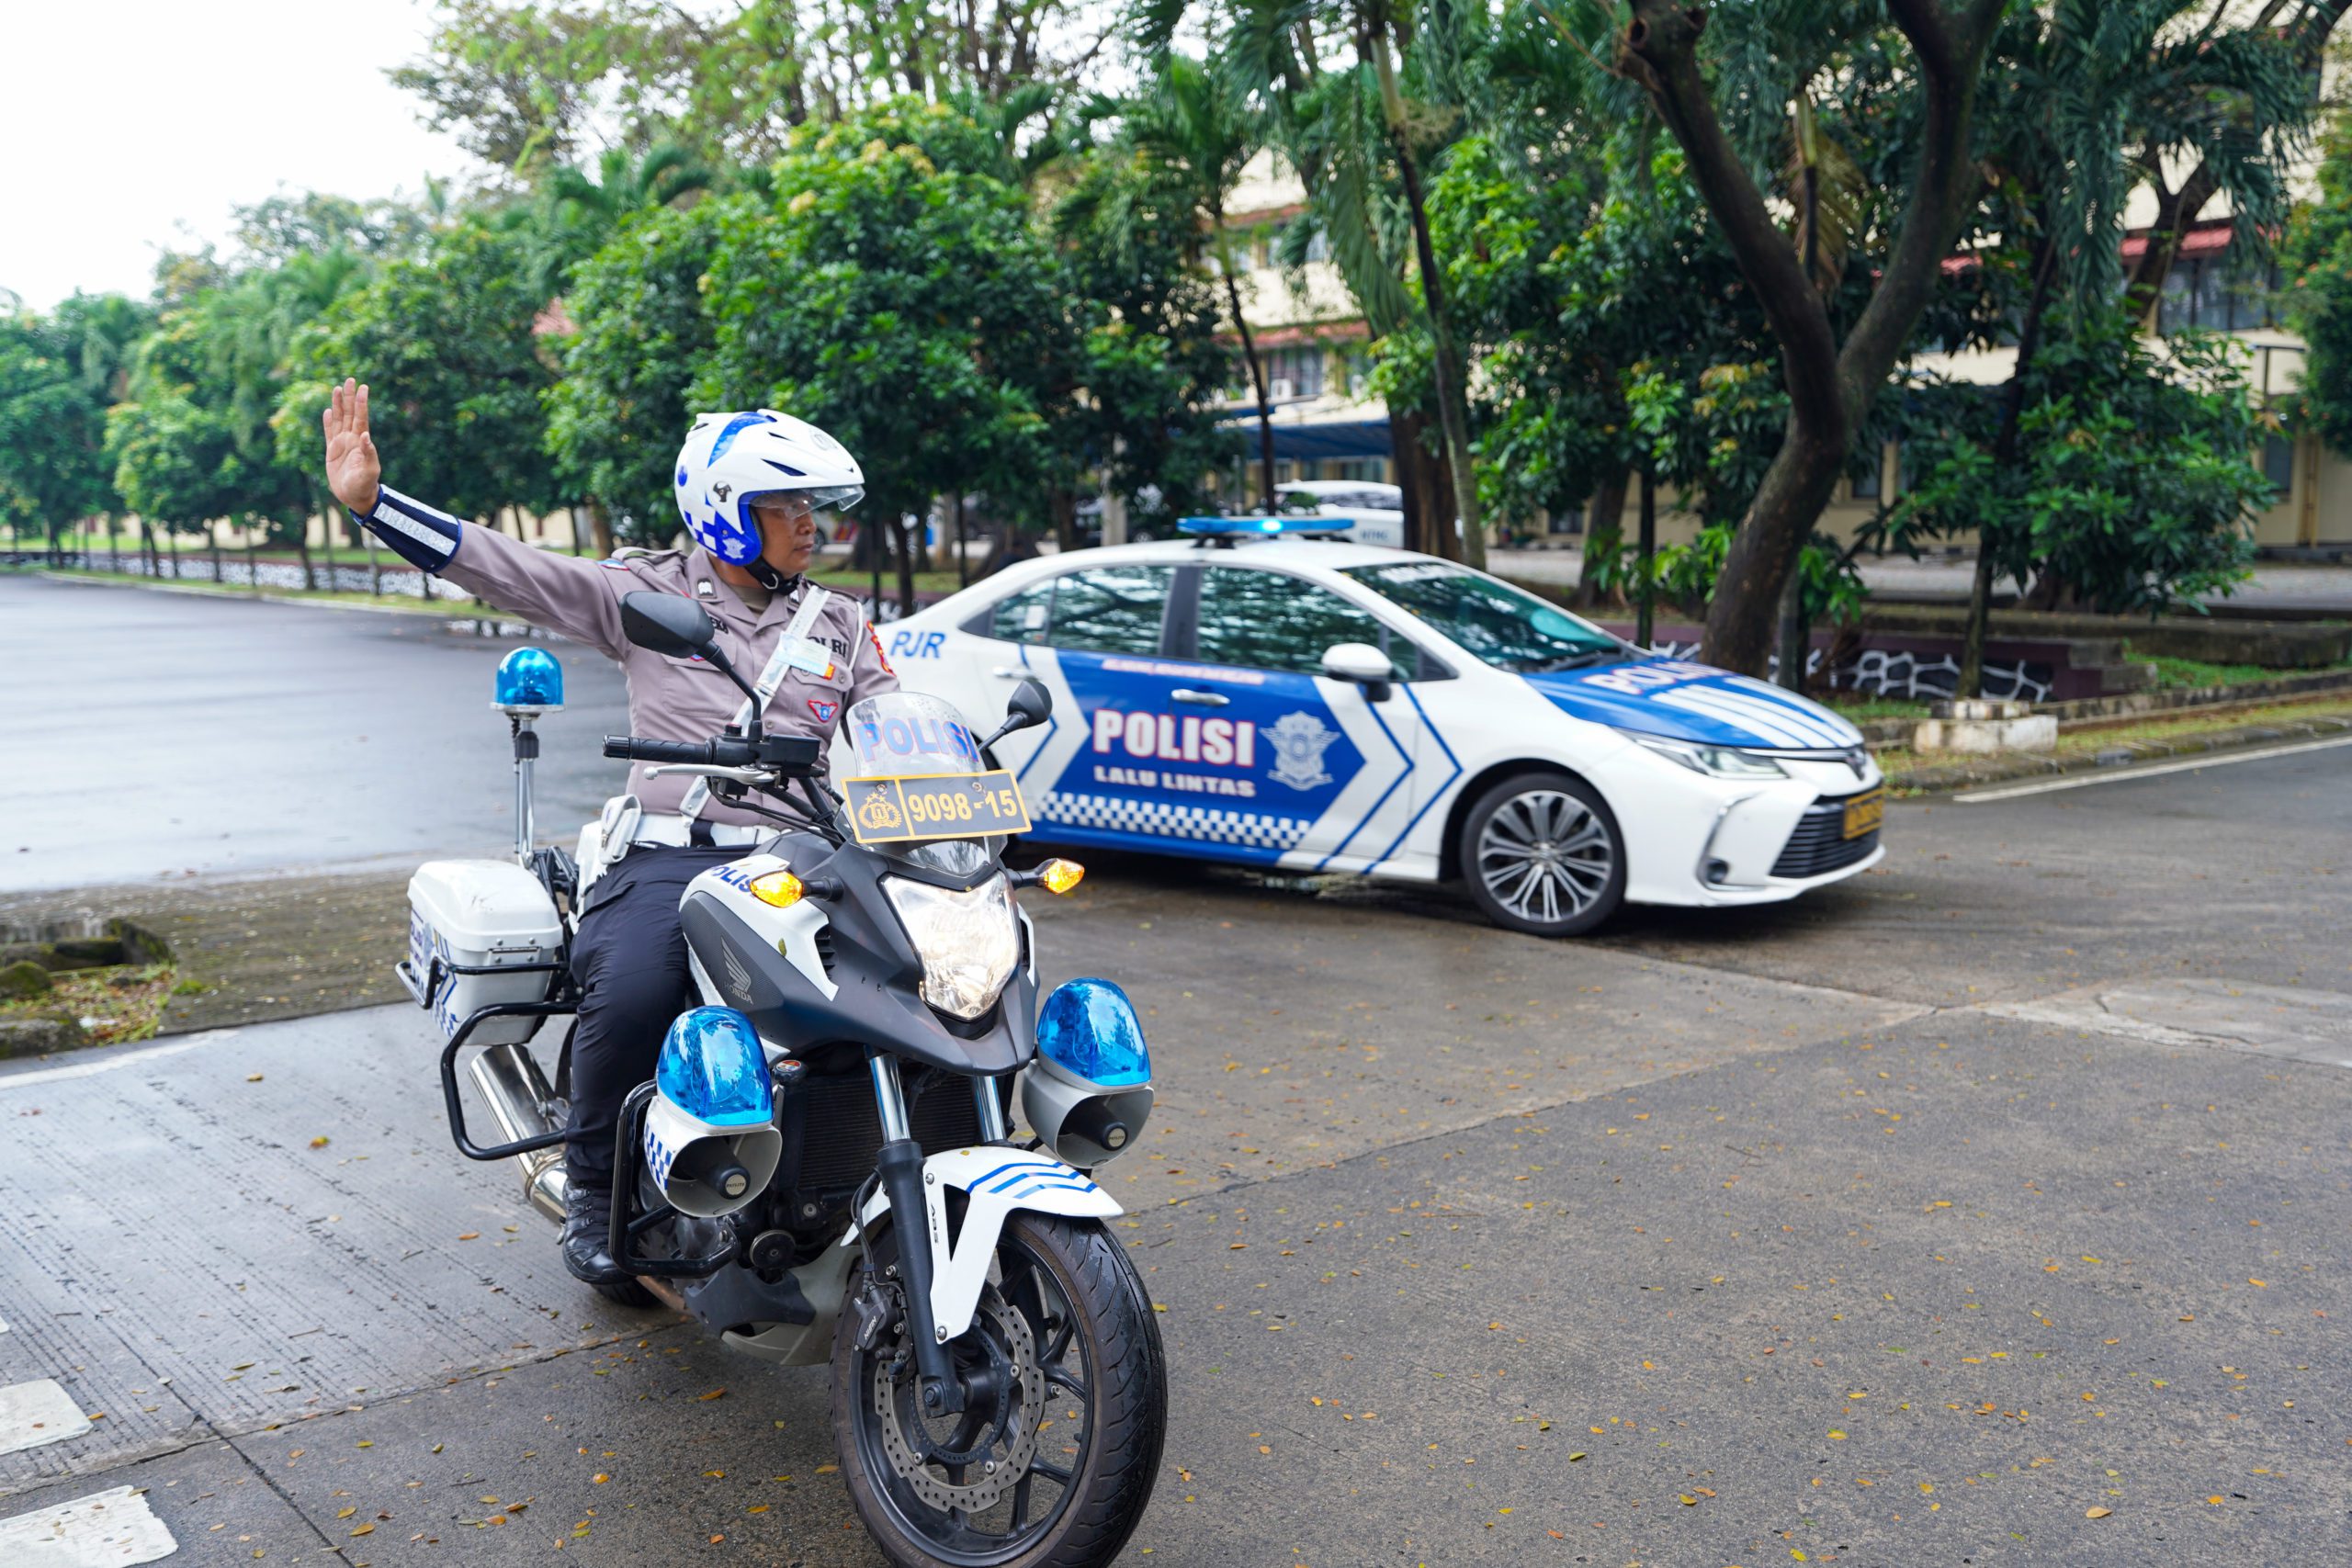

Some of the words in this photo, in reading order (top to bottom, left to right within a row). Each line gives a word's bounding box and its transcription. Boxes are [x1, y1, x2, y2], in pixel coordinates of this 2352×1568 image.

[889, 631, 946, 660] PJR
[854, 716, 979, 763] POLISI
[1092, 708, 1256, 768] POLISI
[1093, 765, 1158, 788] LALU
[1161, 772, 1257, 798] LINTAS
[908, 789, 1017, 823] 9098-15
[712, 864, 752, 893] OLIS
[722, 982, 754, 1005] HONDA
